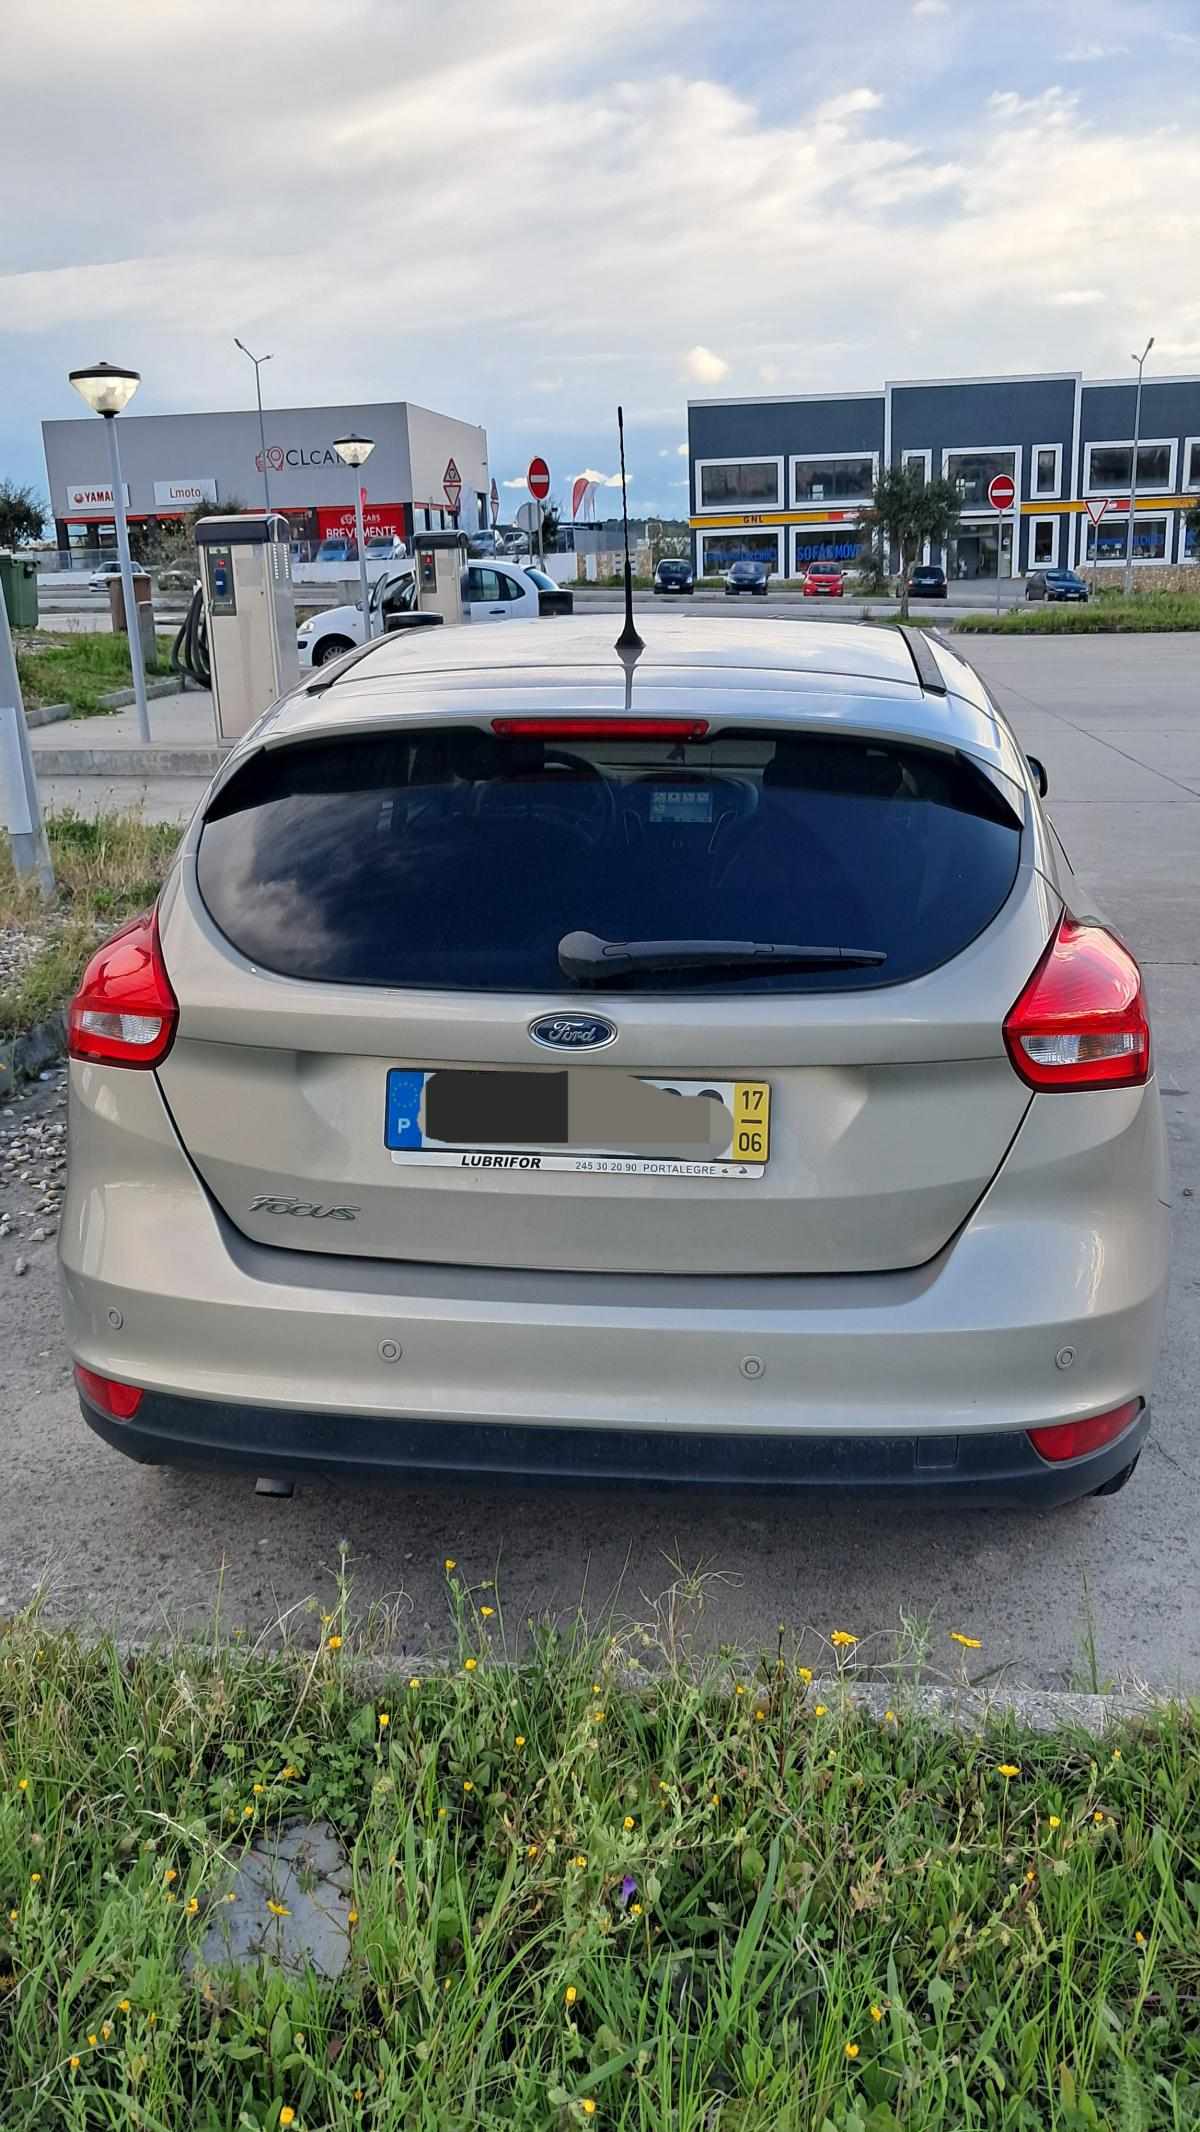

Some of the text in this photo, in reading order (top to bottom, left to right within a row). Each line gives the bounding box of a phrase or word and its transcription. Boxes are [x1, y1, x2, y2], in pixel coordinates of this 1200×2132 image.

[286, 448, 347, 466] CLCAR
[84, 491, 114, 503] YAMA
[549, 1021, 597, 1041] Ford
[742, 1090, 764, 1111] 17
[397, 1118, 411, 1134] P
[738, 1132, 762, 1152] 06
[461, 1155, 717, 1175] LUBRIFOR 245 30 20 90 PORTALEGRE
